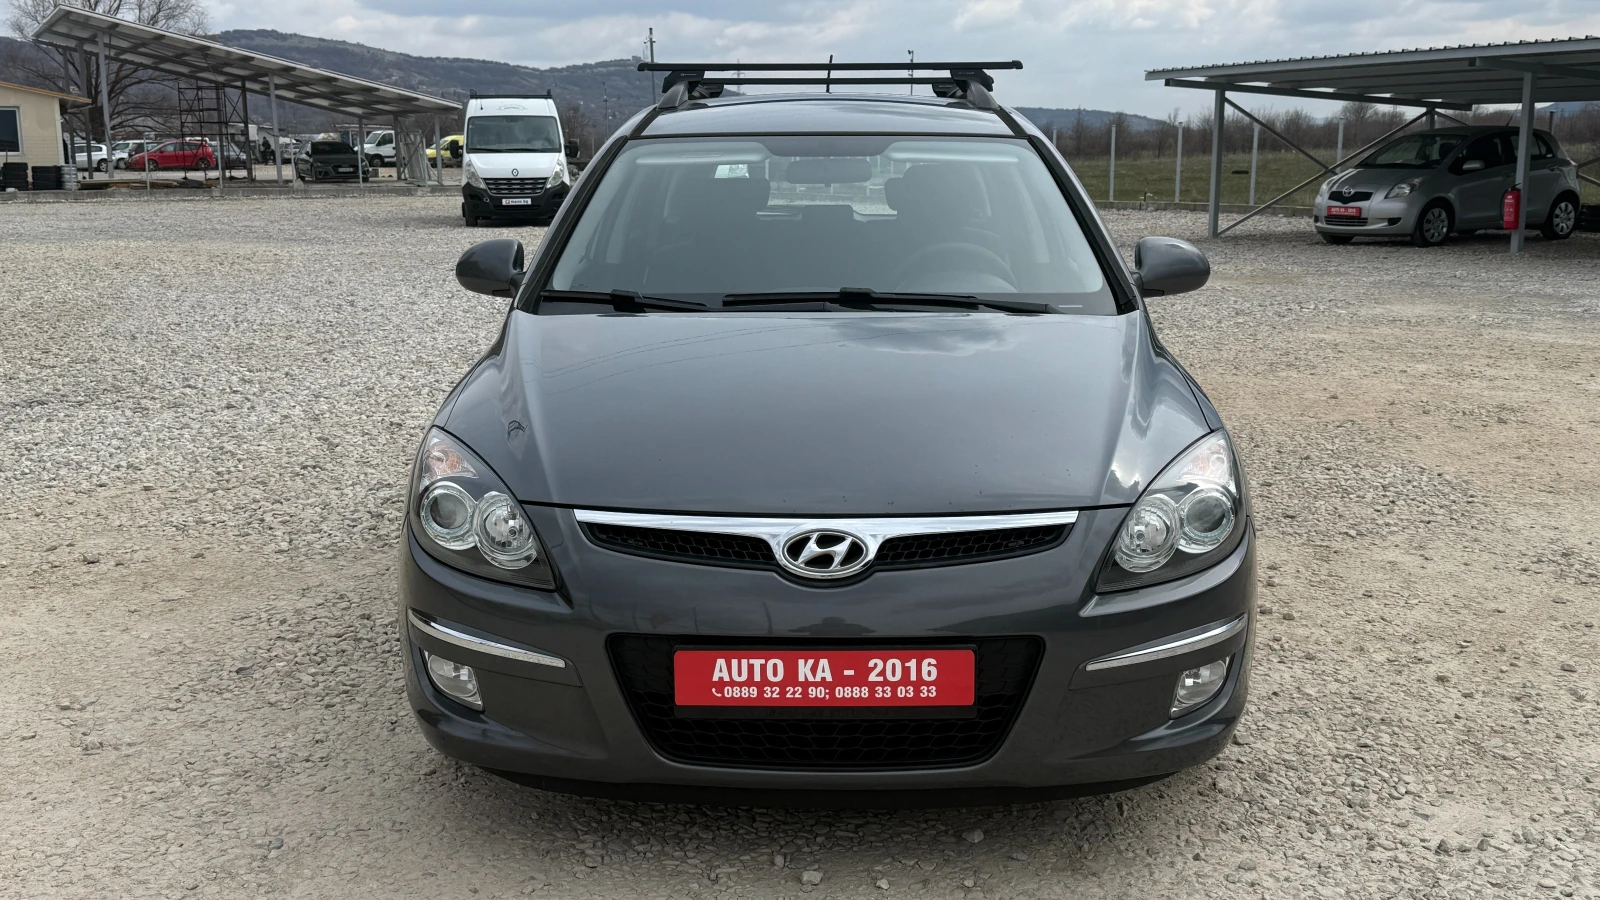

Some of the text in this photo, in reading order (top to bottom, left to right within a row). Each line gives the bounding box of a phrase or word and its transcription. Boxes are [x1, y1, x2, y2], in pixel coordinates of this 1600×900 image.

[712, 658, 785, 682] AUTO
[797, 658, 833, 682] KA
[867, 657, 938, 682] 2016
[724, 686, 937, 700] 0889 32 22 90; 0888 33 03 33
